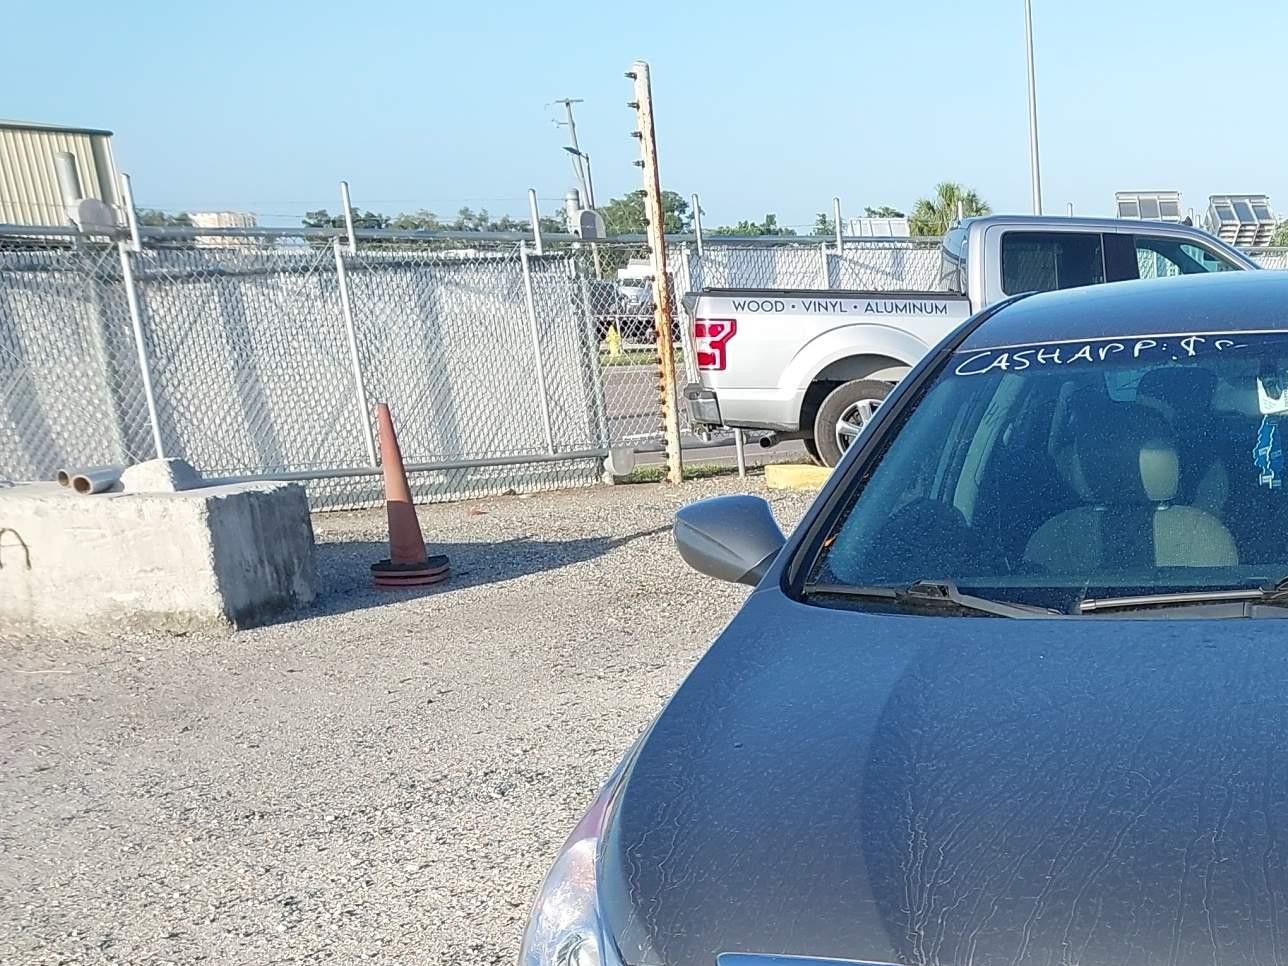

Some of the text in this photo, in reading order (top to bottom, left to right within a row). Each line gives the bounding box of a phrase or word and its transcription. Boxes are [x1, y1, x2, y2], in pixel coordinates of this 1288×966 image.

[732, 300, 948, 315] WOOD VINYL ALUMINUM
